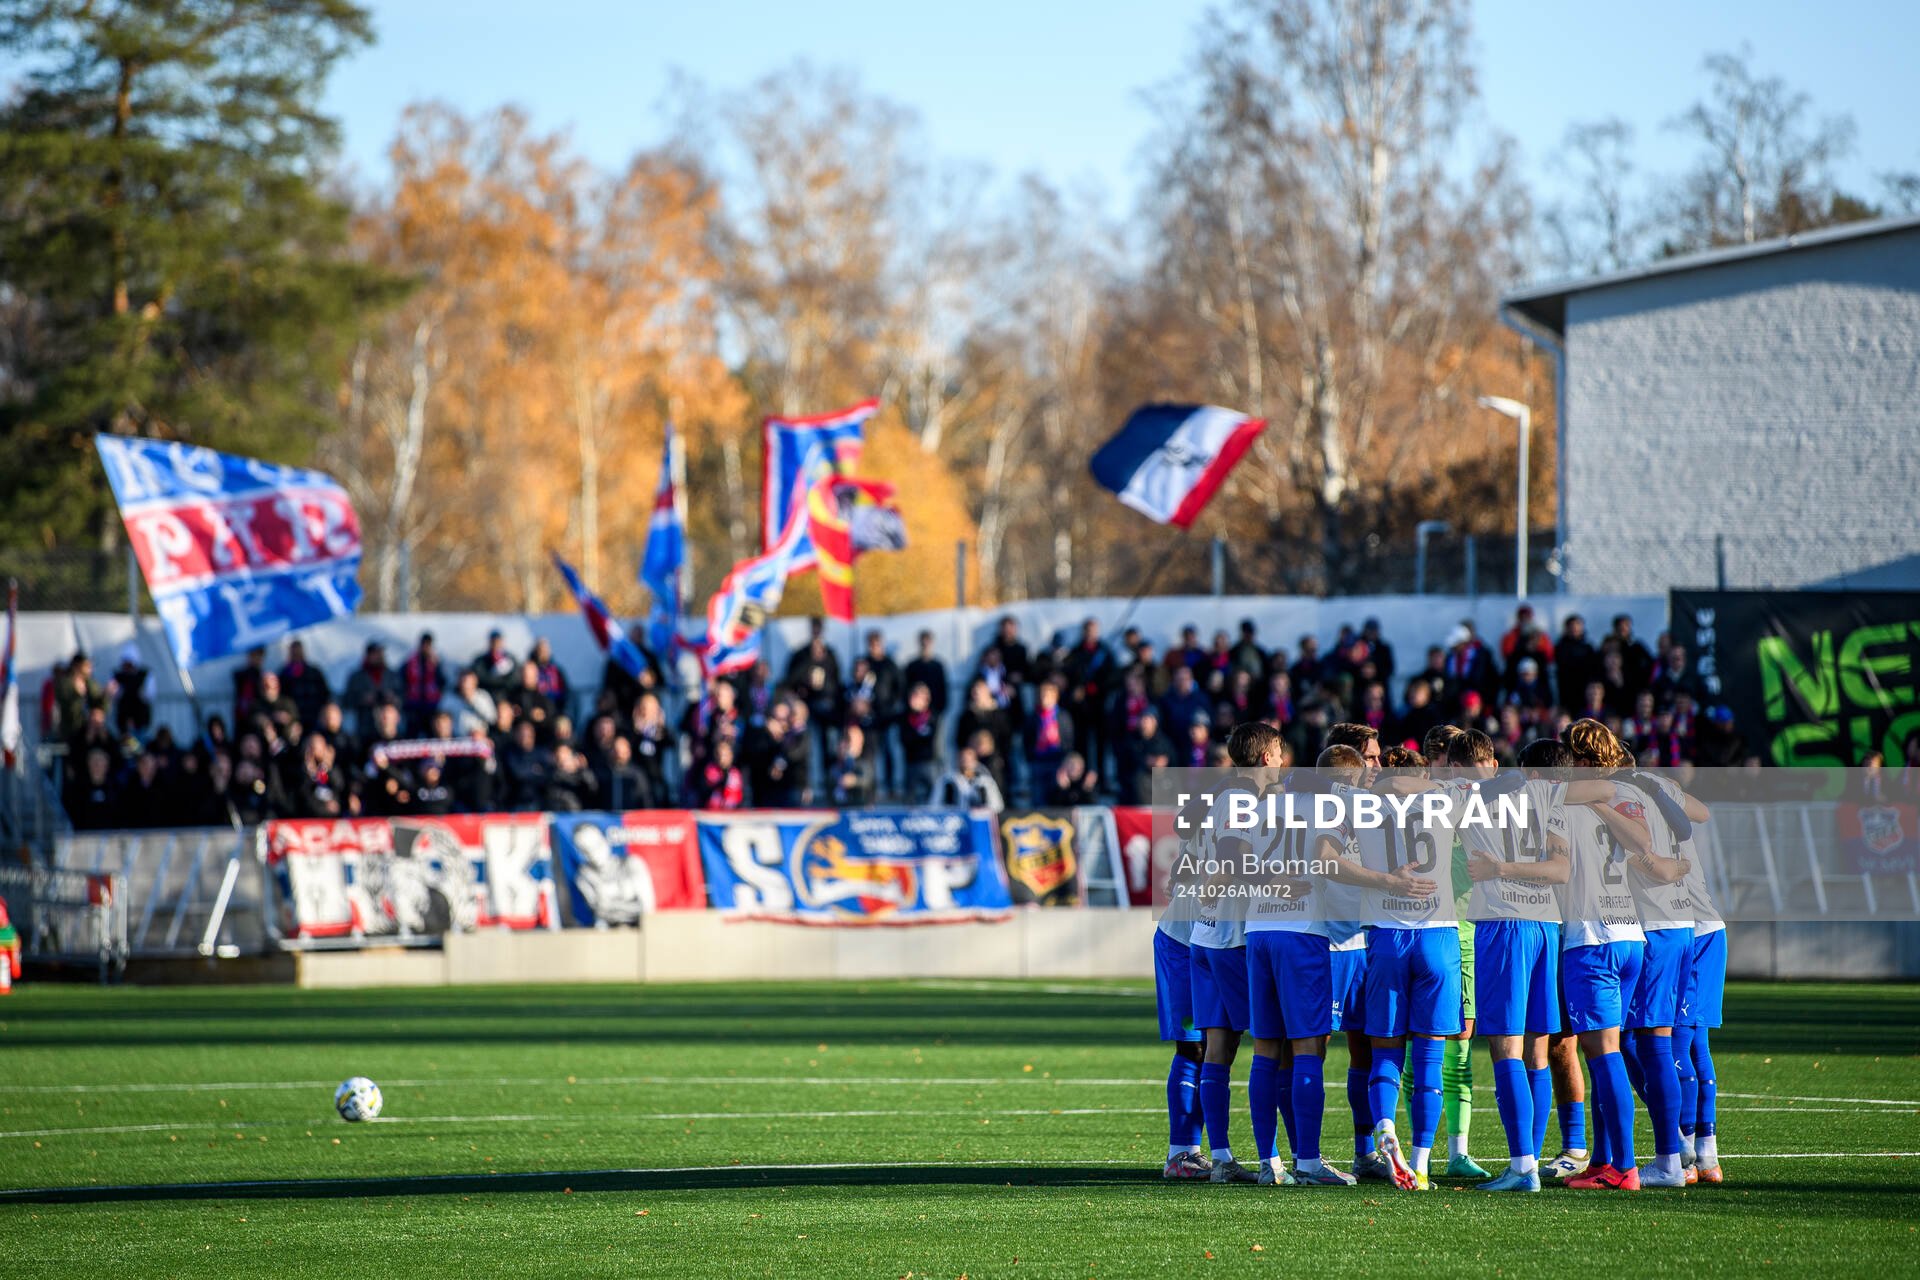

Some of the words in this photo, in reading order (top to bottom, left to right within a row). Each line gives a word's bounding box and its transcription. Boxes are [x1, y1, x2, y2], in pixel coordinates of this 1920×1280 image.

[1378, 812, 1437, 875] 16
[1382, 897, 1438, 911] tillmobil
[1502, 890, 1551, 905] tillmobil
